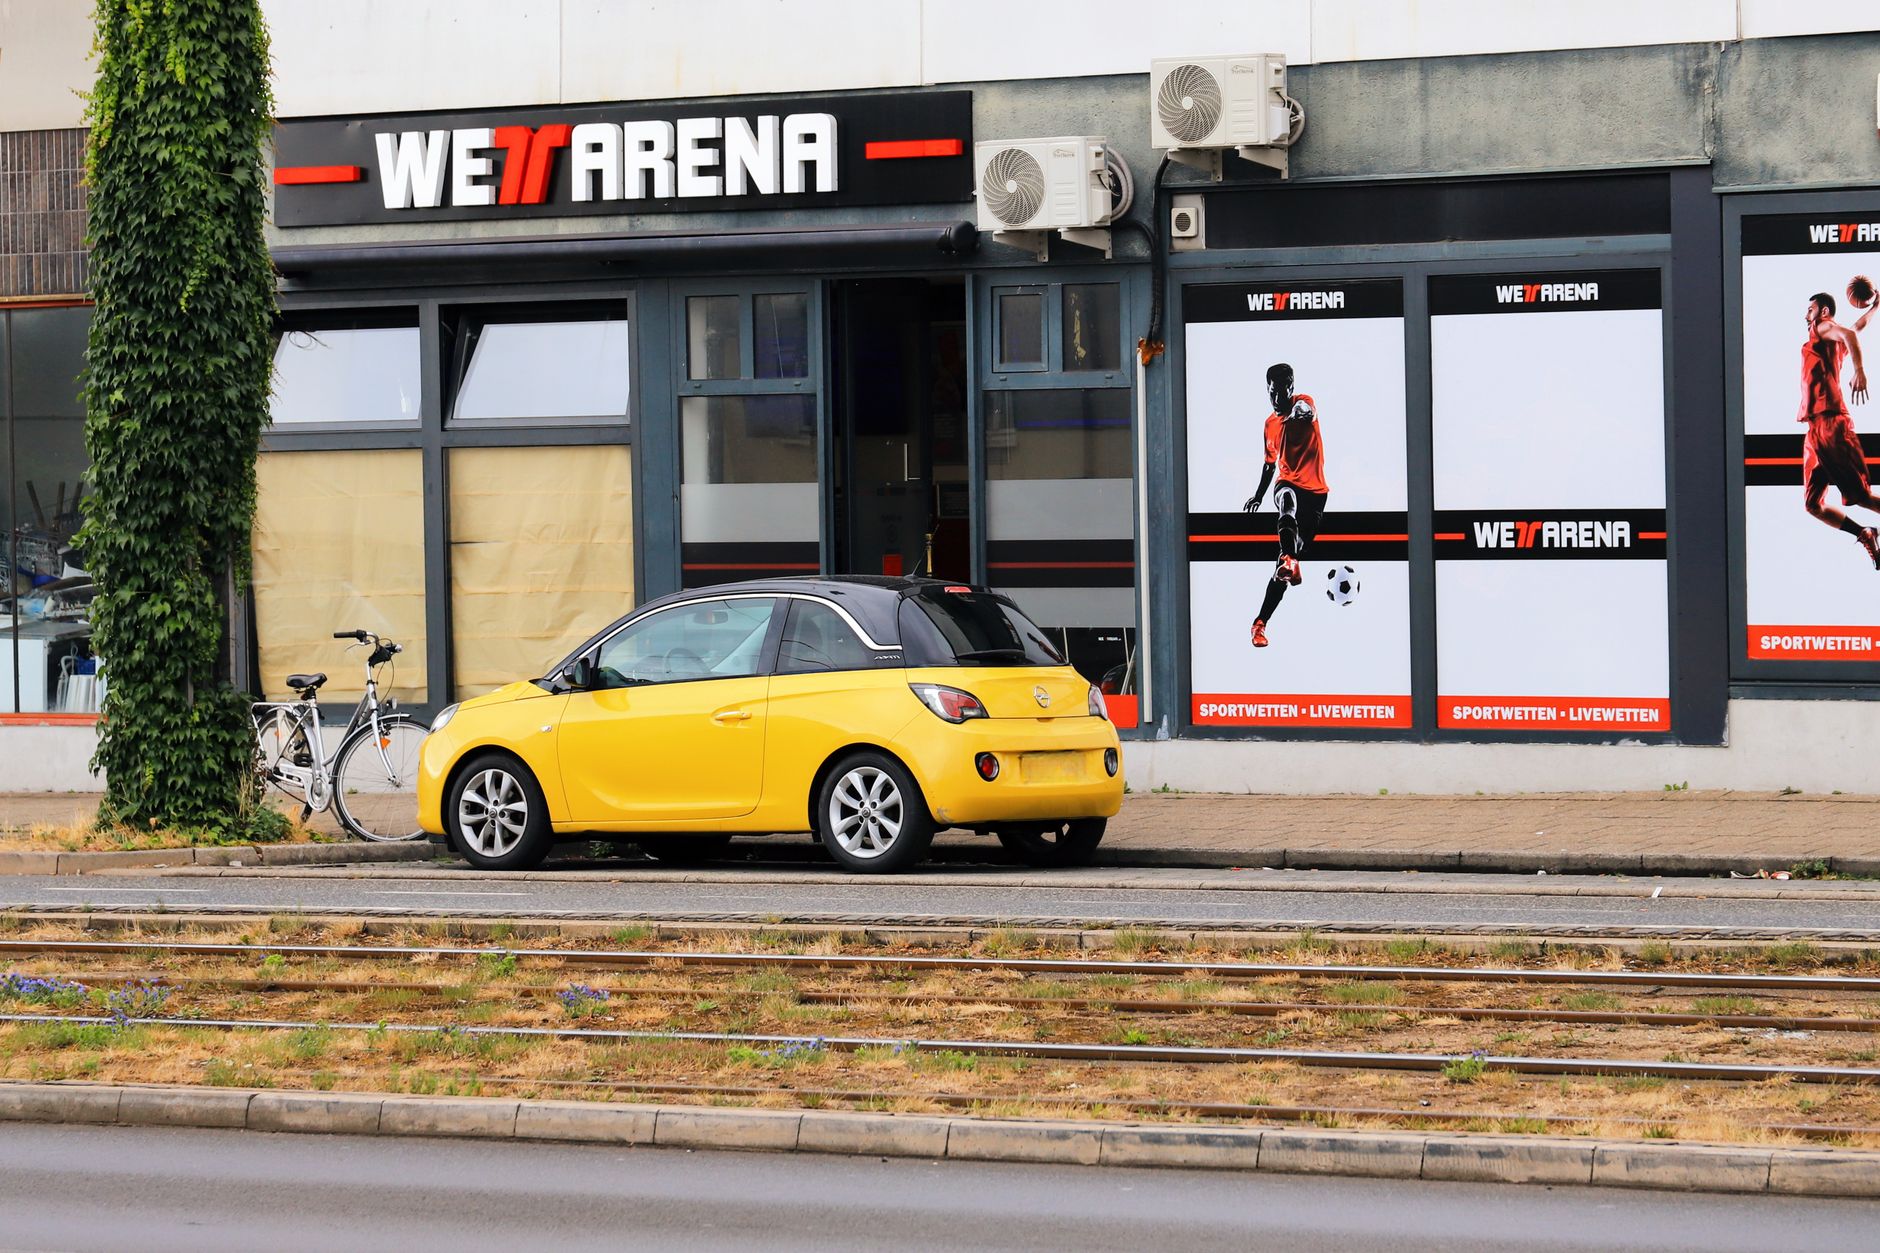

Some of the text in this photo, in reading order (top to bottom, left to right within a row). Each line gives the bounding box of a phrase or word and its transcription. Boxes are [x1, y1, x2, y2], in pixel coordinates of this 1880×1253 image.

[1760, 635, 1872, 651] SPORTWETTEN
[1199, 703, 1396, 719] SPORTWETTEN LIVEWETTEN
[1452, 706, 1660, 722] SPORTWETTEN LIVEWETTEN
